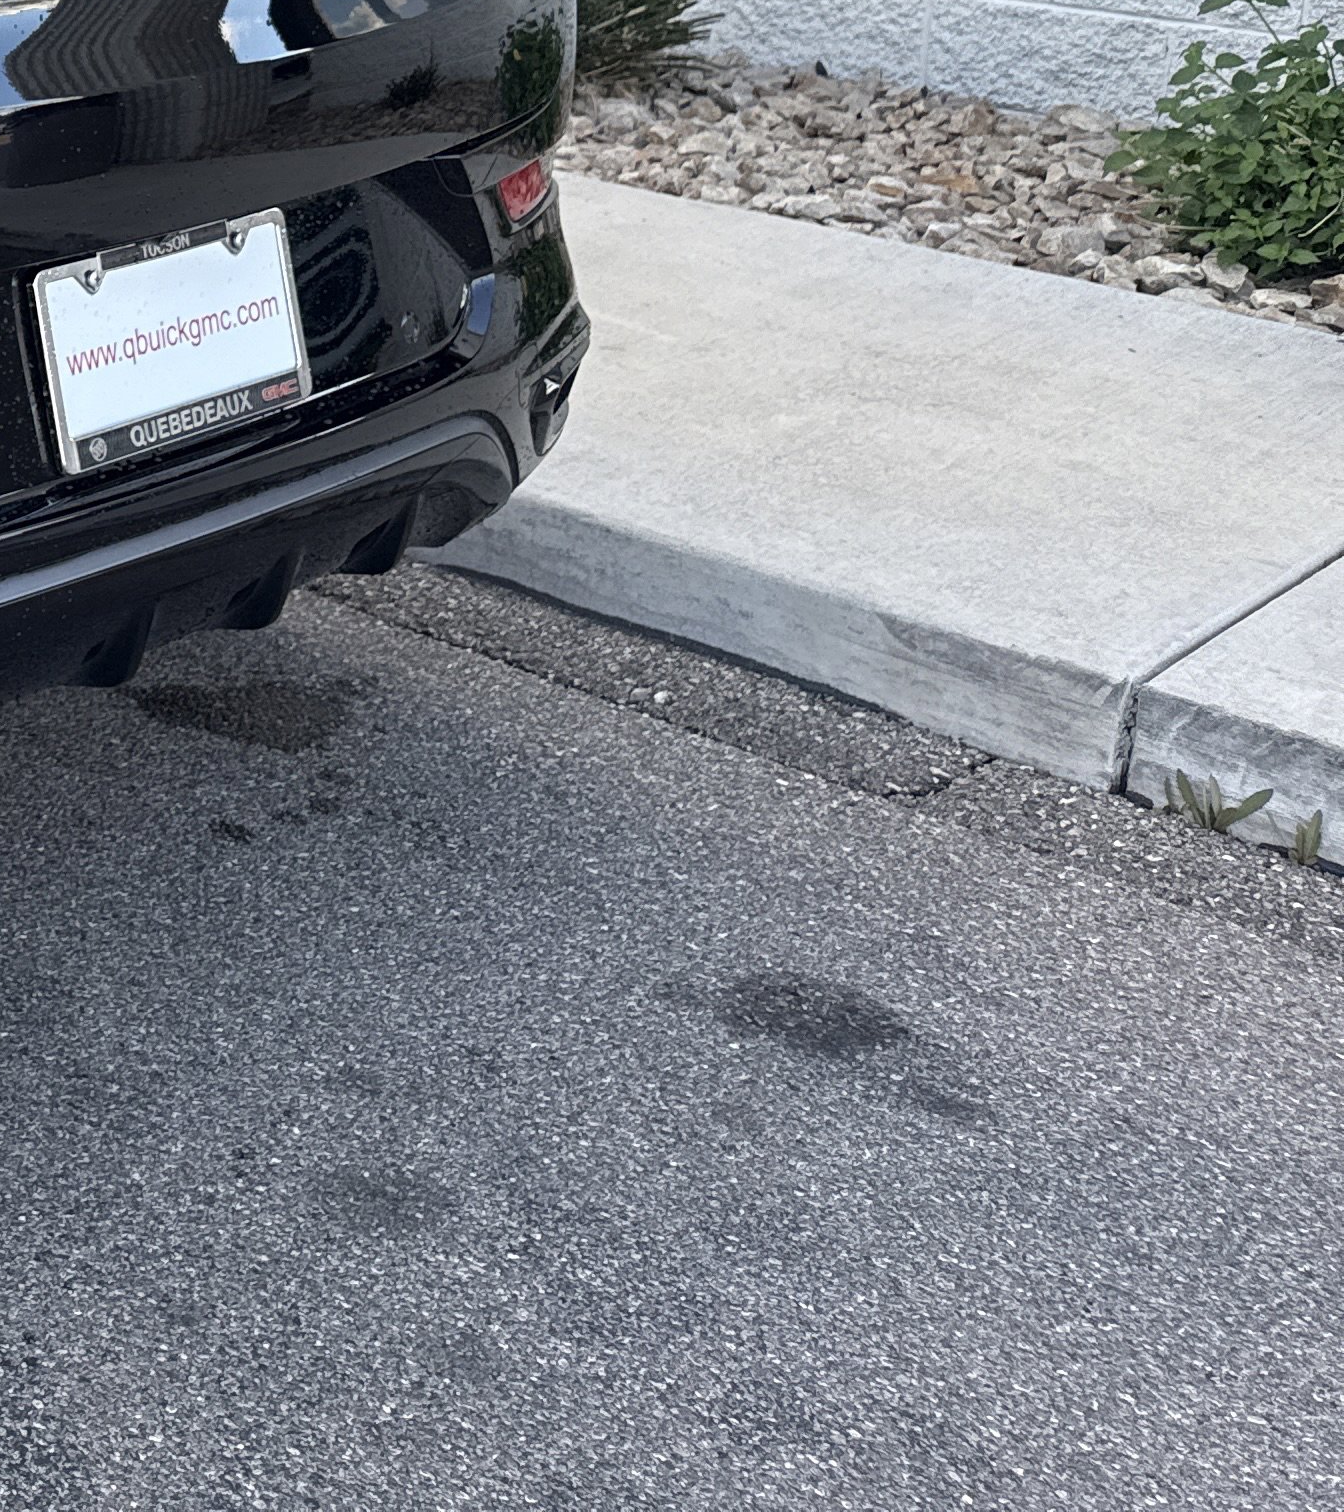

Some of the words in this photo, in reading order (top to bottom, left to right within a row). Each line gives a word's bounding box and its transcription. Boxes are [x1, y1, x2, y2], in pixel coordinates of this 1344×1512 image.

[140, 232, 191, 259] TUCSON
[65, 295, 280, 376] www.qbuickgmc.com
[129, 389, 254, 448] QUEBEDEAUX
